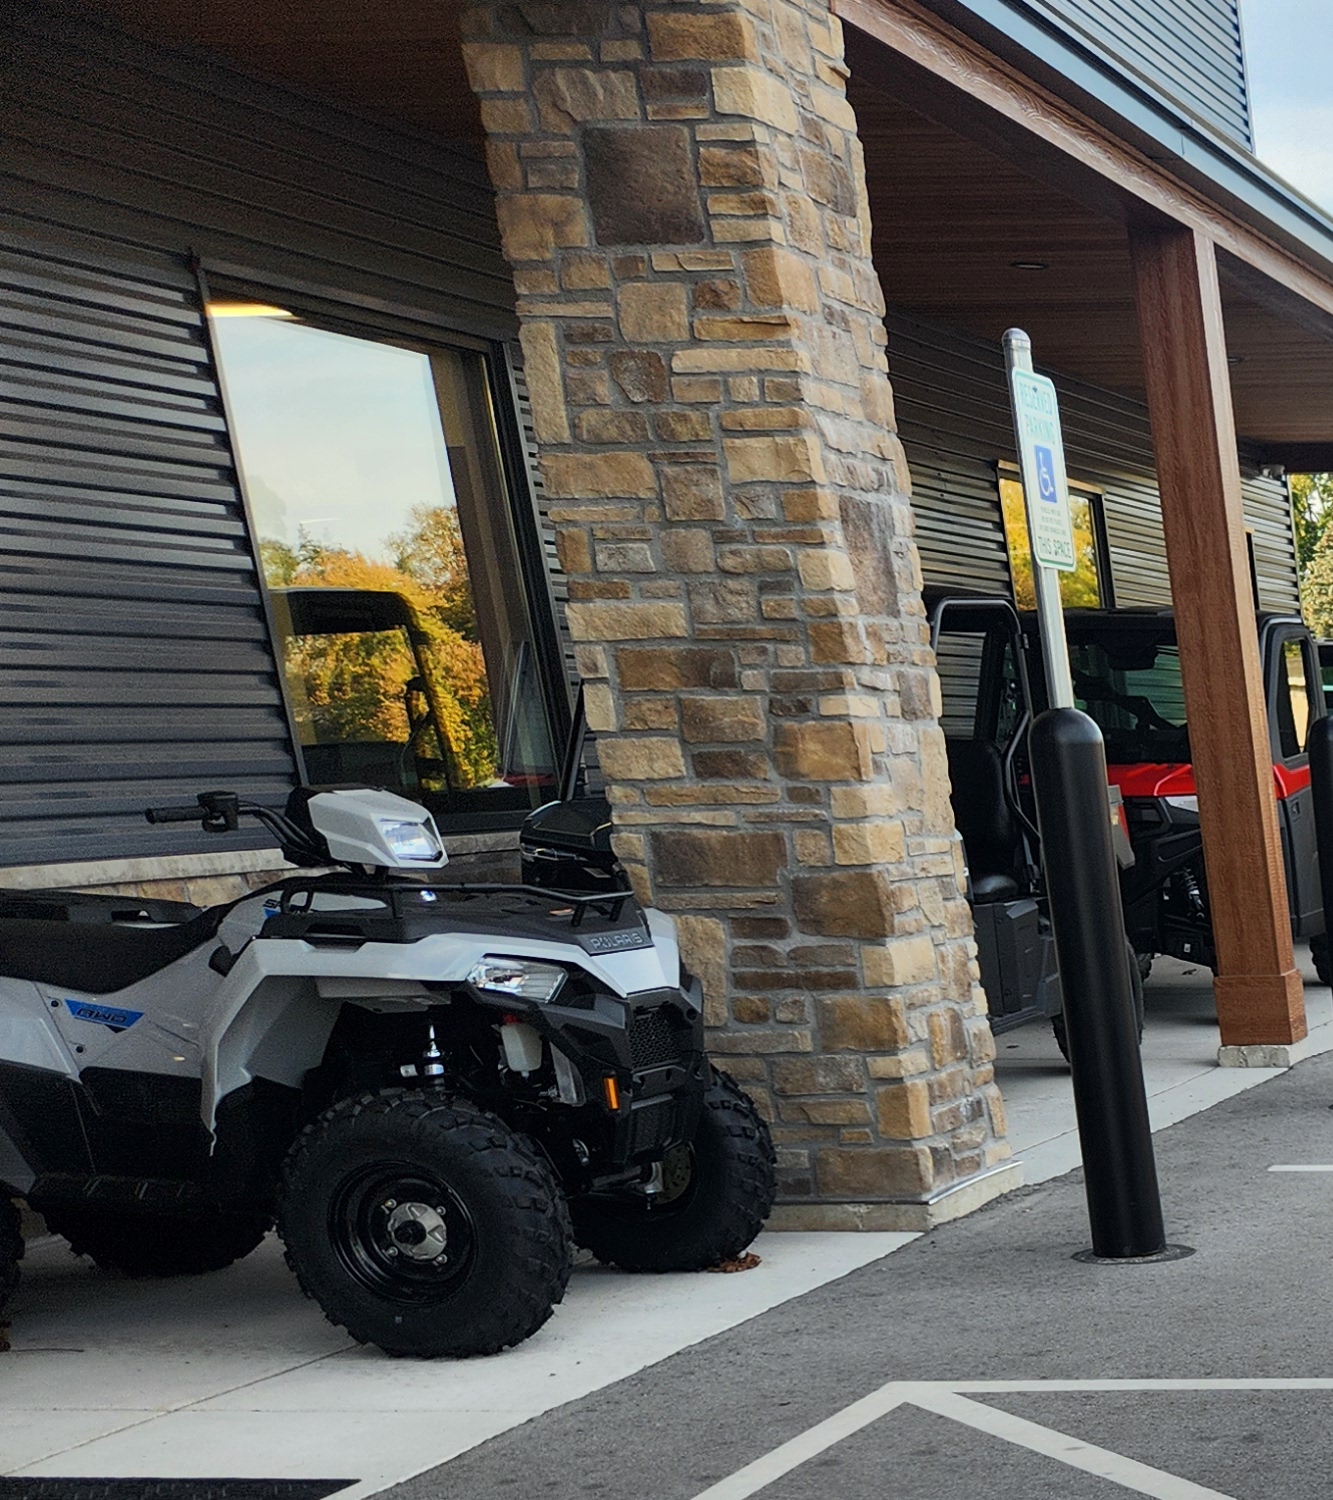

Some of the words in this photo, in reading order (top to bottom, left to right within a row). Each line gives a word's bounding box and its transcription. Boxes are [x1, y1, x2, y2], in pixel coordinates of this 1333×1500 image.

[1024, 413, 1056, 445] PARKING
[1038, 536, 1052, 555] THIS
[1052, 539, 1072, 559] SPACE
[590, 932, 643, 951] POLARIS
